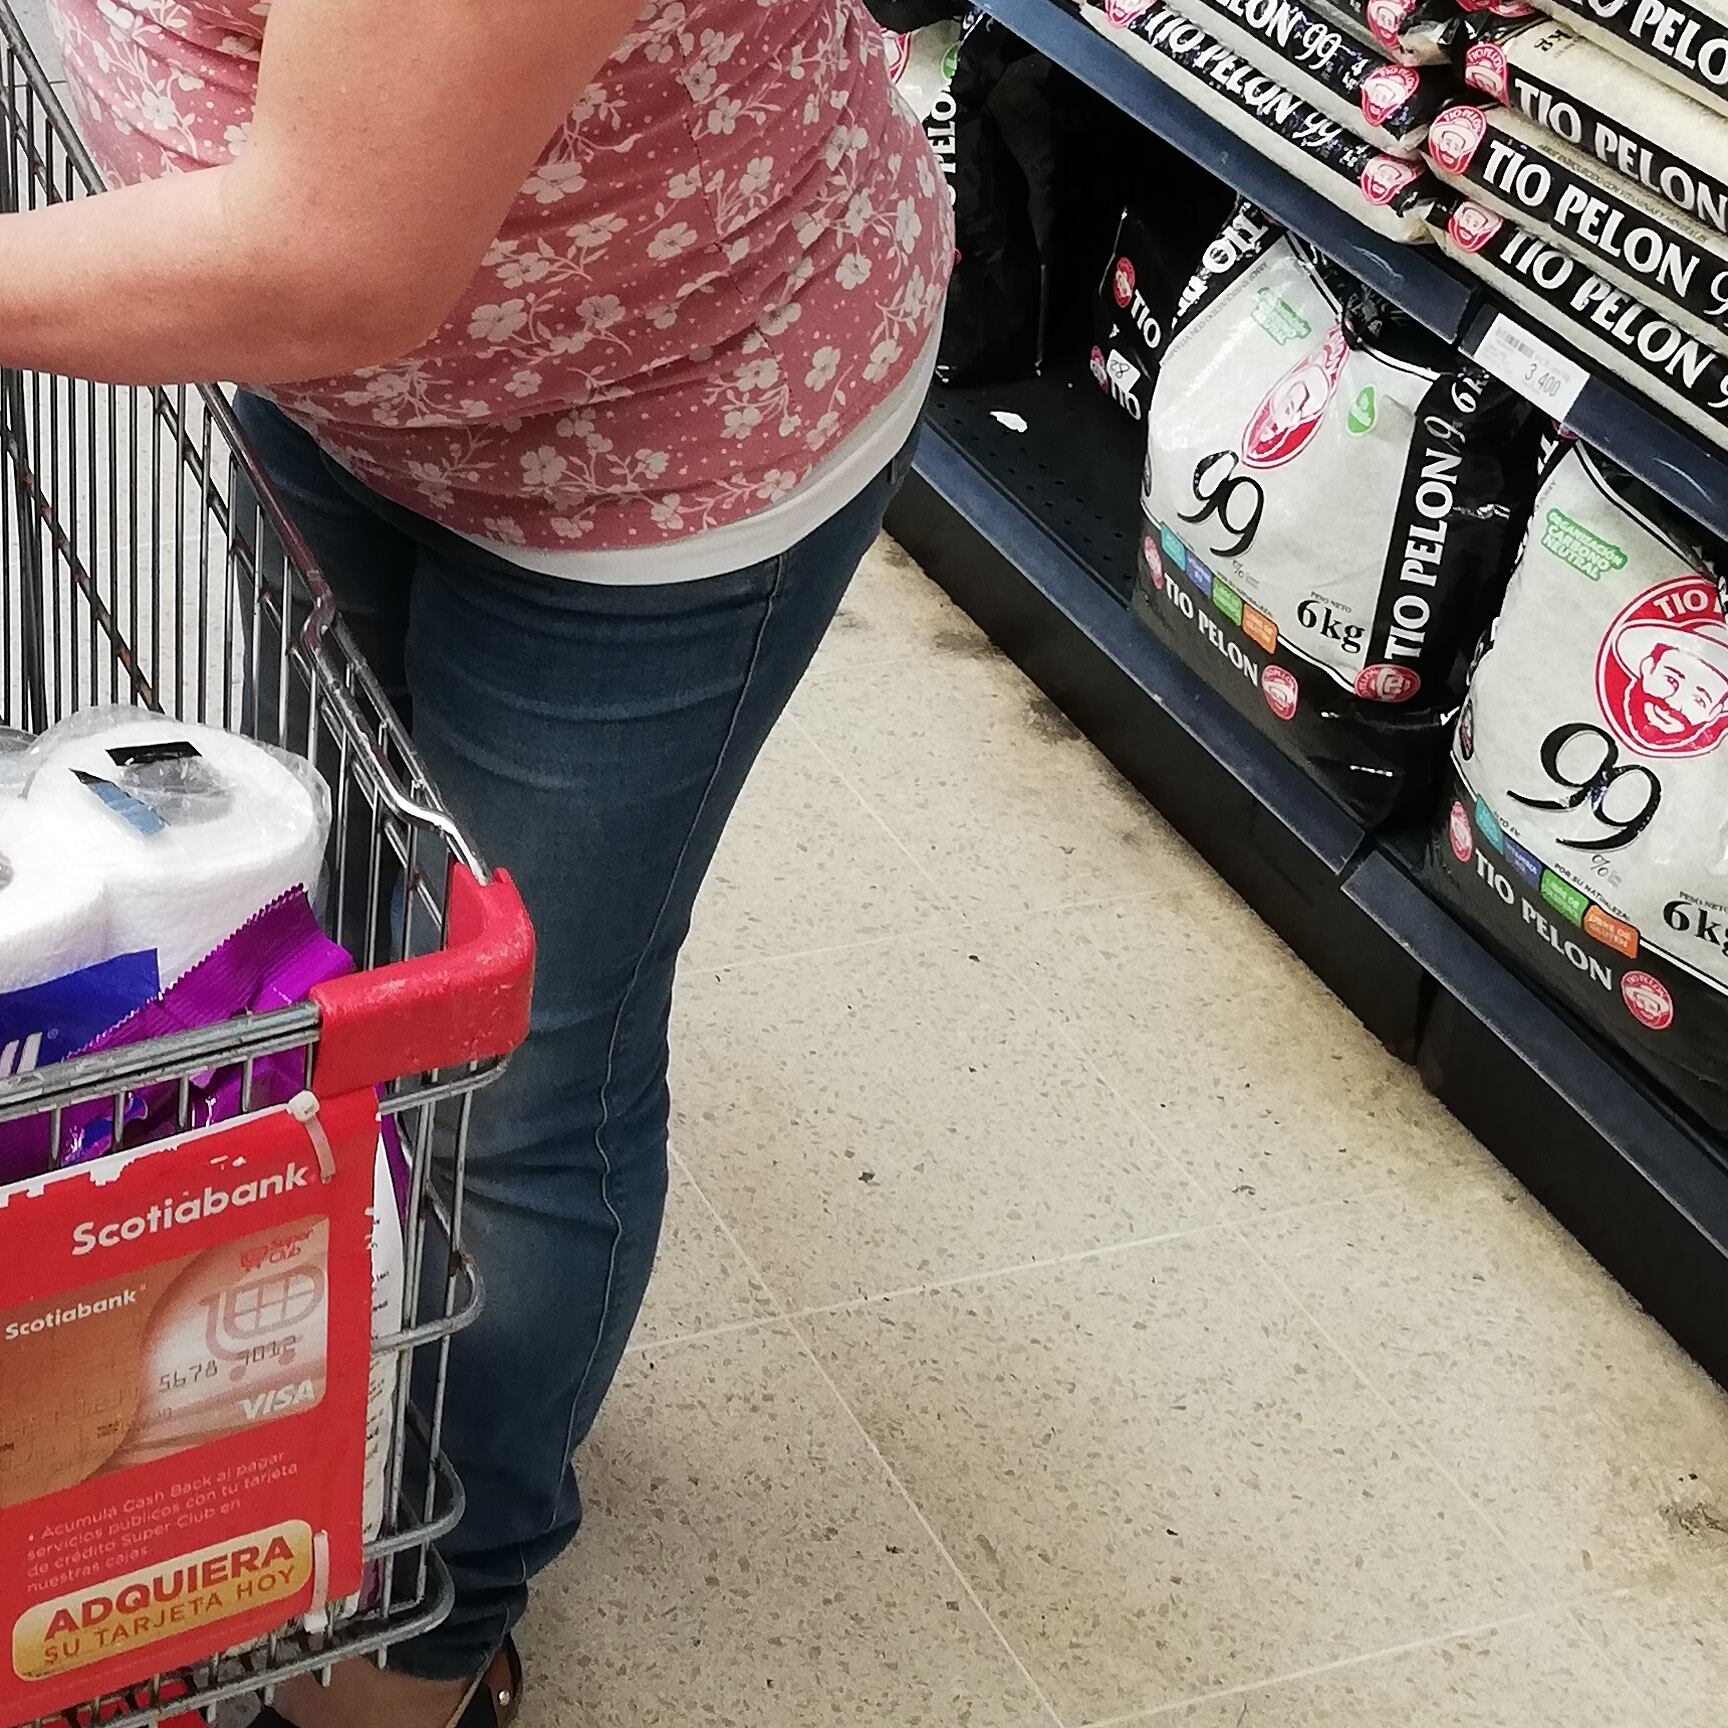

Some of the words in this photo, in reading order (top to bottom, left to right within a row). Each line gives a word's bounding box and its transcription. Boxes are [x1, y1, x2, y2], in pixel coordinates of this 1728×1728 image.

[1515, 78, 1582, 144] TIO
[1595, 122, 1728, 233] PELON
[1482, 139, 1552, 210] TIO
[1554, 191, 1703, 303] PELON
[1129, 289, 1162, 349] TIO
[1178, 450, 1265, 558] 99
[1400, 449, 1454, 596] PELON
[1543, 535, 1599, 579] NEUTRAL
[1548, 525, 1609, 570] CARBONO
[1164, 573, 1193, 618] TIO
[1198, 609, 1258, 687] PELON
[1384, 602, 1432, 661] TIO
[1654, 590, 1708, 619] TIO
[1506, 721, 1663, 851] 99
[1475, 849, 1514, 905] TIO
[1521, 897, 1612, 991] PELON
[70, 1162, 309, 1256] Scotiabank
[5, 1289, 137, 1342] Scotiabank
[158, 1359, 218, 1394] 5678
[239, 1378, 314, 1422] VISA
[27, 1529, 103, 1561] servicios
[186, 1491, 216, 1508] con
[221, 1484, 238, 1497] tu
[244, 1463, 298, 1493] tarjeta
[123, 1491, 165, 1514] Cash
[171, 1476, 212, 1498] Back
[217, 1470, 231, 1483] al
[235, 1452, 286, 1479] pagar
[27, 1563, 99, 1592] nuestras
[28, 1562, 49, 1578] de
[54, 1540, 116, 1569] crédito
[122, 1523, 171, 1549] Super
[177, 1507, 215, 1529] Club
[221, 1499, 241, 1514] en
[43, 1534, 296, 1643] ADQUIERA
[44, 1634, 81, 1666] SU
[91, 1595, 224, 1650] TARJETA
[236, 1564, 296, 1604] HOY
